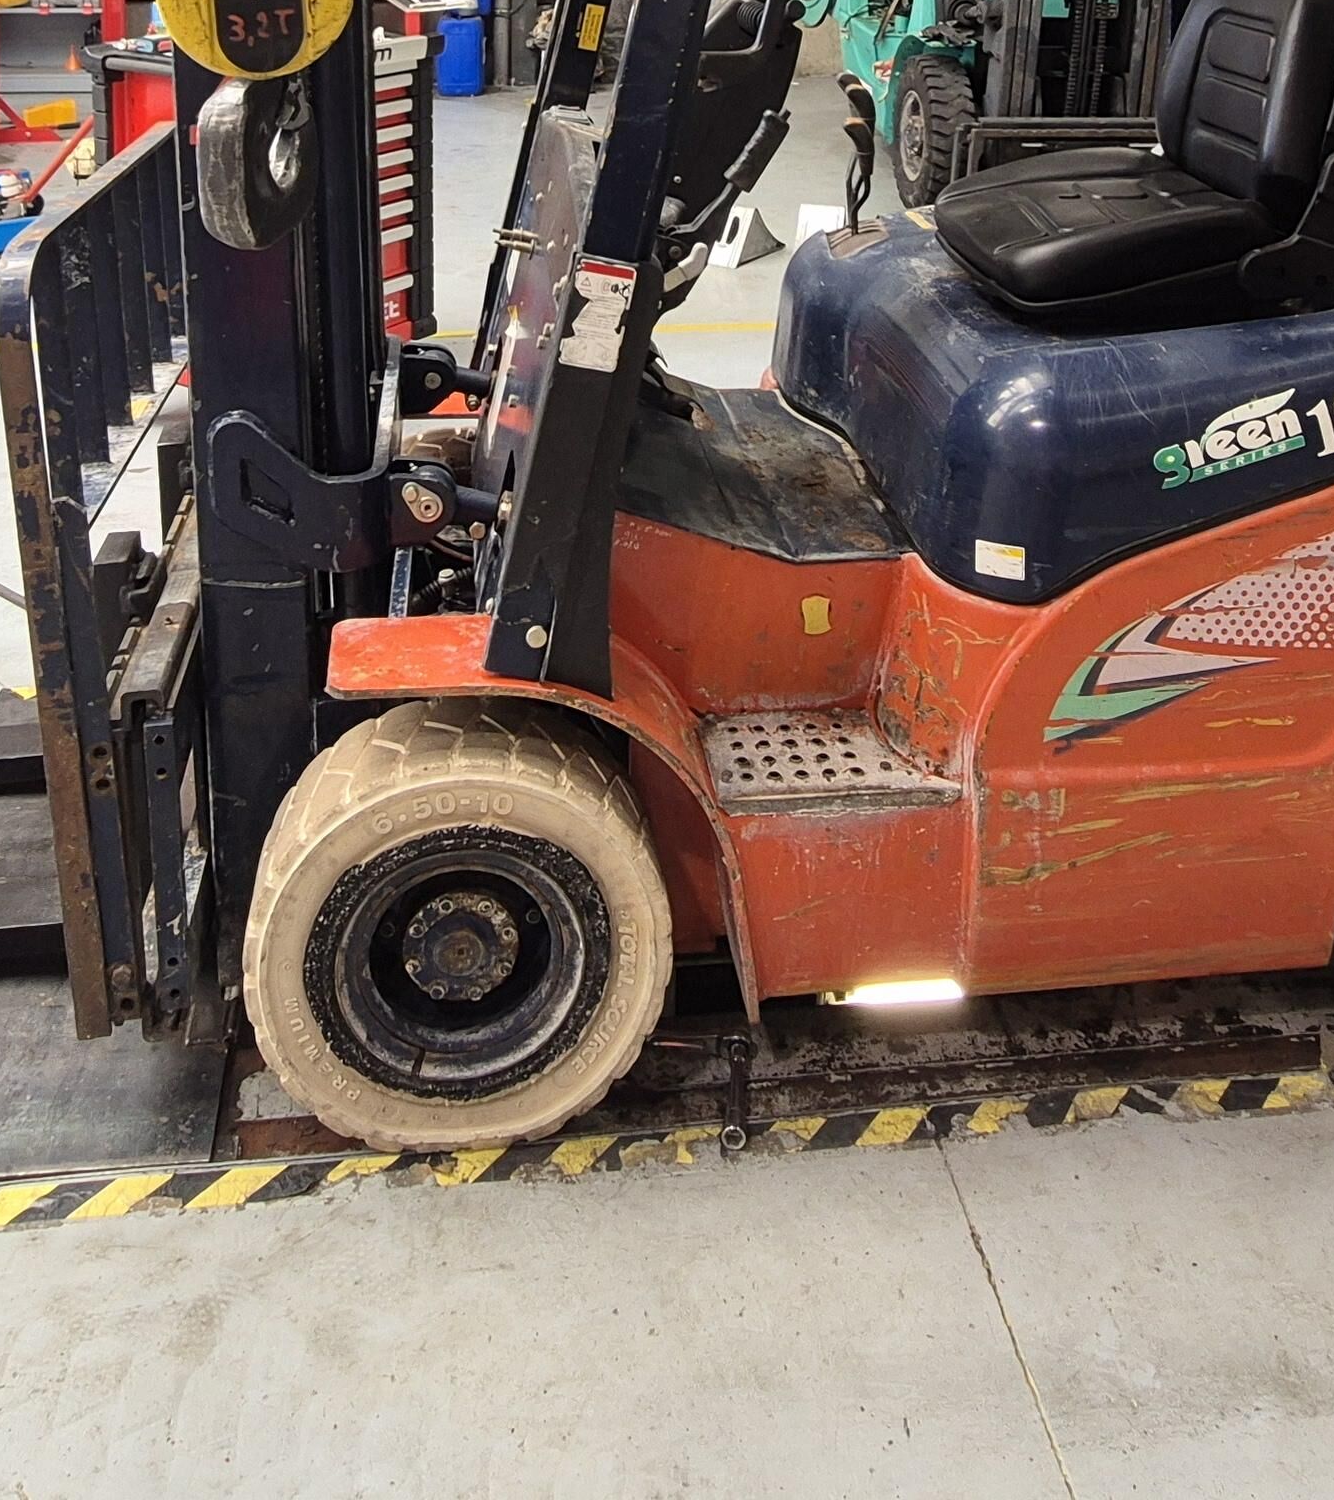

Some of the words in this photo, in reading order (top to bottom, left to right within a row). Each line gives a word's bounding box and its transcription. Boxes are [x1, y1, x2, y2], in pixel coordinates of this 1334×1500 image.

[1153, 388, 1303, 490] green
[1203, 442, 1288, 476] SERIES
[284, 997, 362, 1102] PREMIUM
